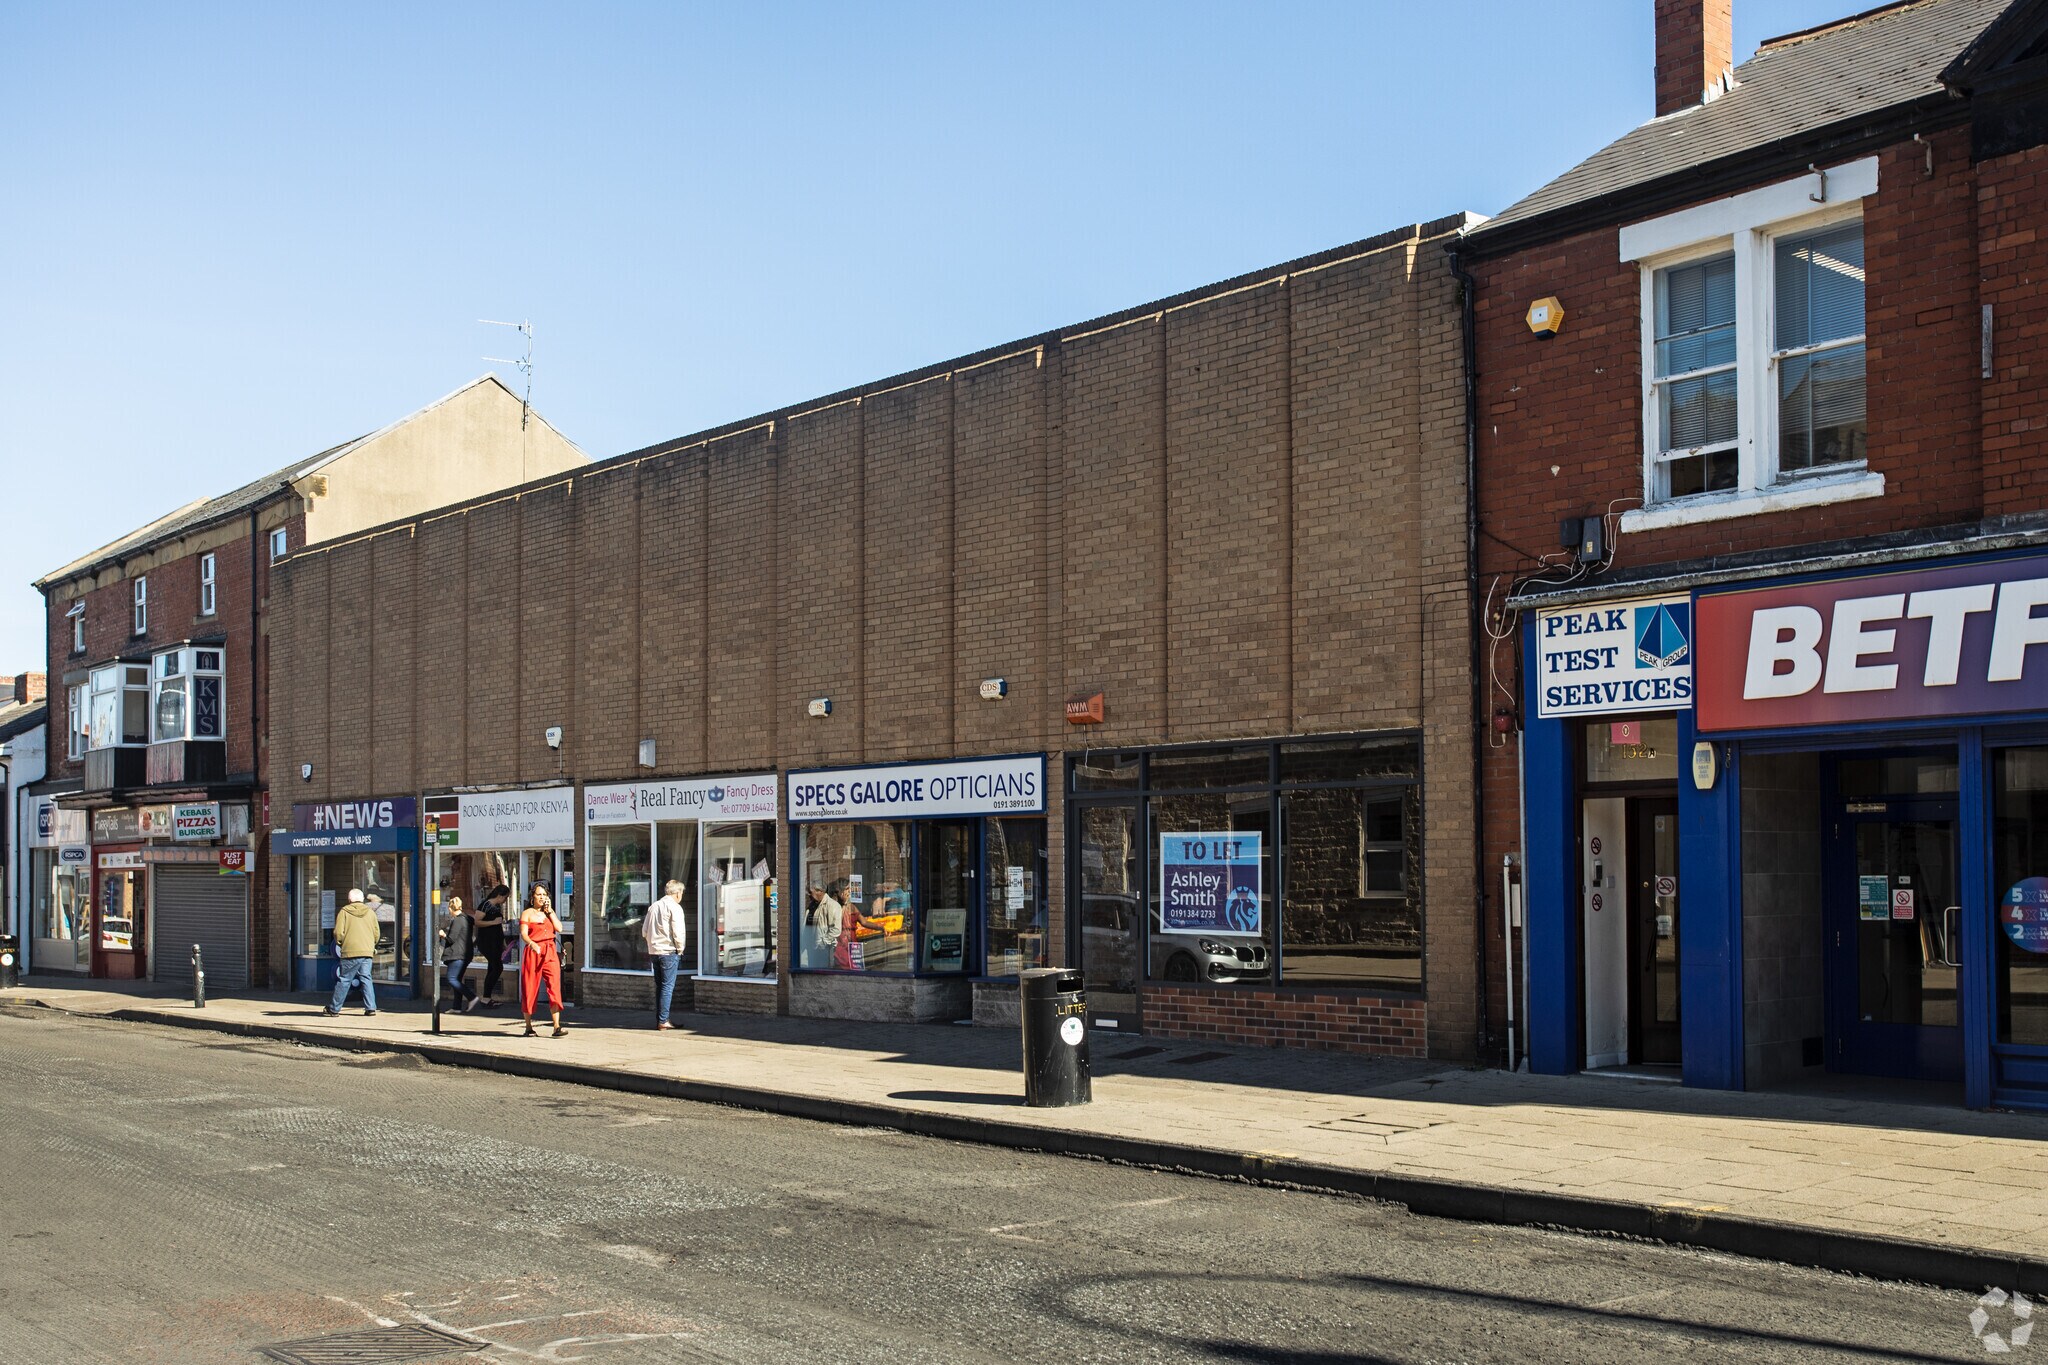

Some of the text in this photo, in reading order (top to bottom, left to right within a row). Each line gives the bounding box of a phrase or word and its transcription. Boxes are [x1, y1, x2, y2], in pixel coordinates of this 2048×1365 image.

[1545, 609, 1627, 638] PEAK
[1546, 647, 1619, 673] TEST
[1639, 646, 1688, 668] PEAK GROUP
[1546, 676, 1692, 708] SERVICES
[1066, 701, 1088, 713] AWM
[726, 783, 774, 800] Fancy Dress
[795, 771, 1035, 807] SPECS GALORE OPTICIANS
[588, 792, 628, 805] Dance Wear
[641, 786, 706, 809] Real Fancy
[1009, 799, 1035, 808] 3891100
[180, 808, 212, 816] KEBABS
[462, 800, 569, 817] BOOKS & BREAD FOR KENYA
[721, 802, 774, 813] Tel: 07709 164422
[795, 808, 848, 818] www.specsgalore.co.uk
[40, 816, 54, 827] RSPCA
[177, 817, 216, 828] PIZZAS
[313, 801, 393, 831] #NEWS
[179, 828, 215, 836] BURGERS
[494, 821, 536, 833] CHARITY SHOP
[292, 837, 331, 848] CONFECTIONERY
[334, 836, 351, 846] DRINKS
[355, 835, 372, 845] VAPES
[1182, 841, 1242, 860] TO LET
[1171, 871, 1221, 891] Ashley
[1170, 889, 1216, 906] Smith
[1170, 909, 1186, 917] 0191
[1187, 910, 1199, 918] 384
